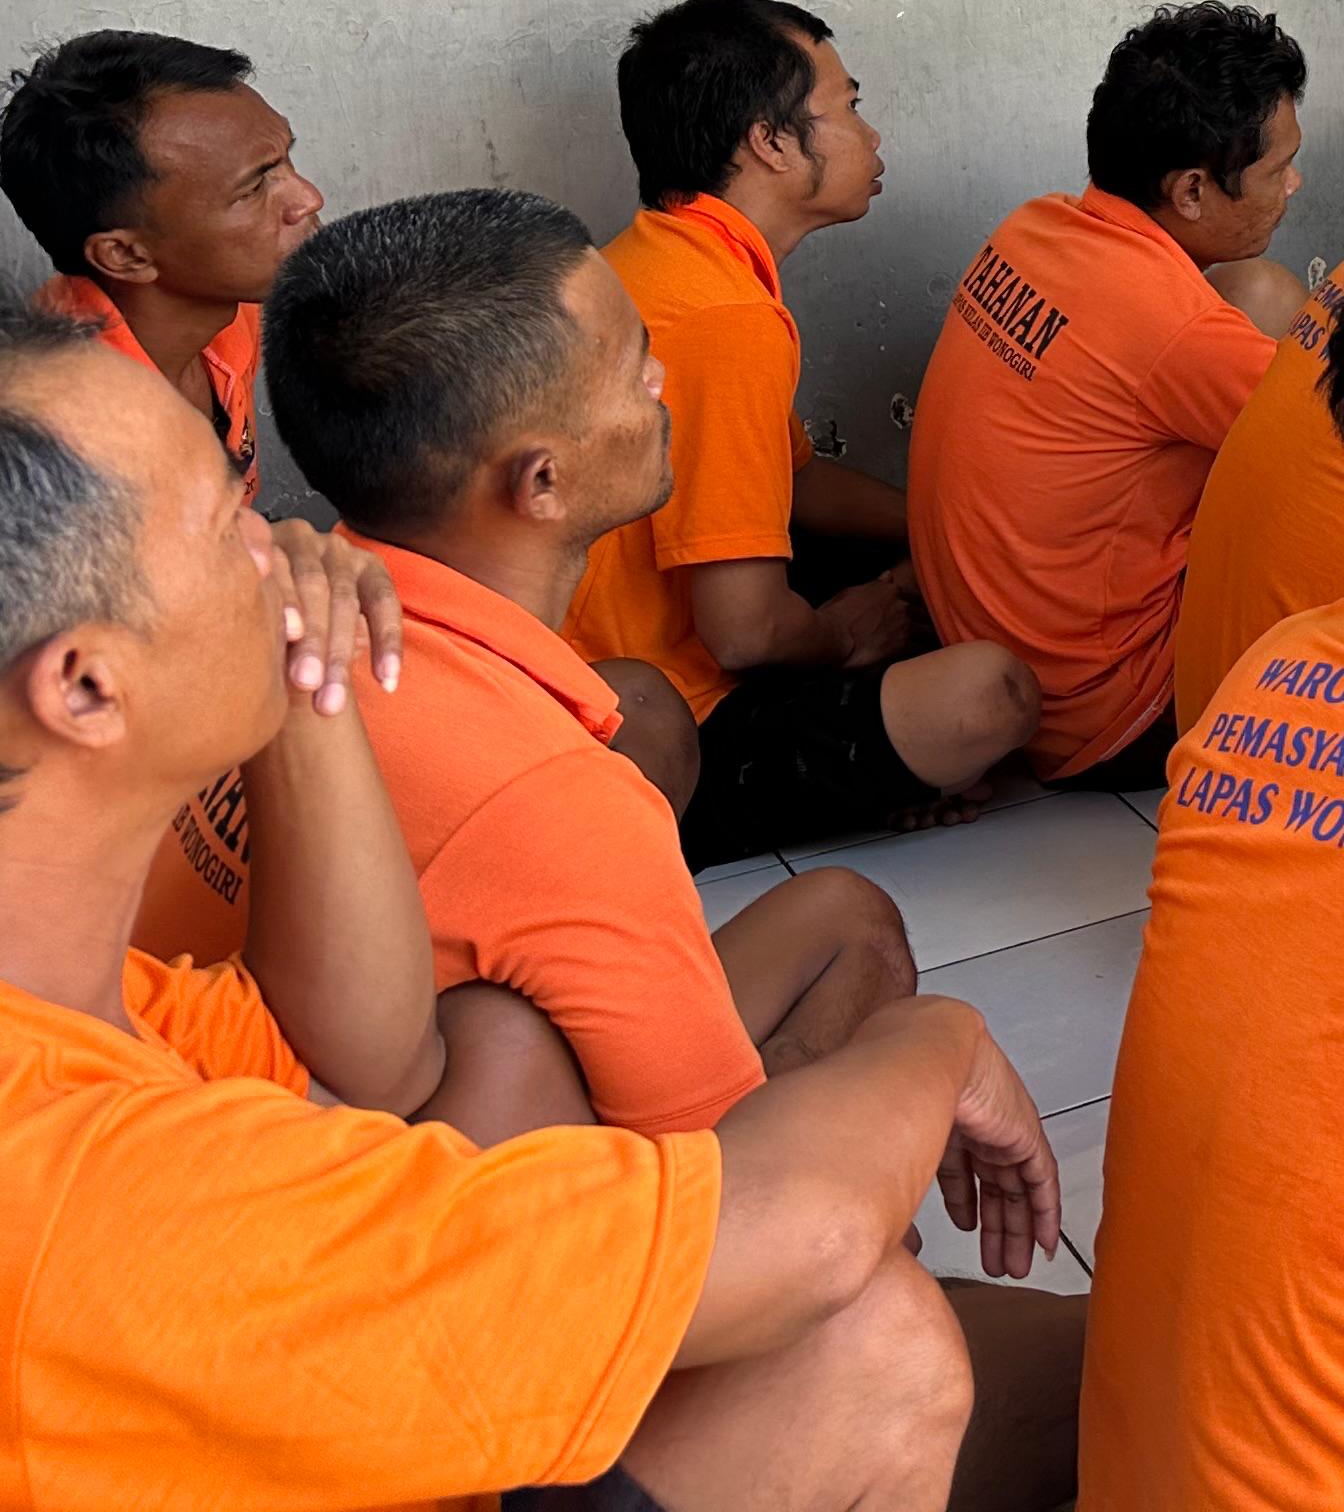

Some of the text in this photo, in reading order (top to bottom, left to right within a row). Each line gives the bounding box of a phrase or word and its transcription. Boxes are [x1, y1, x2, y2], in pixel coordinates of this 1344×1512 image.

[963, 244, 1069, 360] TAHANAN
[987, 331, 1036, 382] WONOGIRI
[1177, 766, 1279, 825] LAPAS
[180, 815, 243, 905] WONOGIRI
